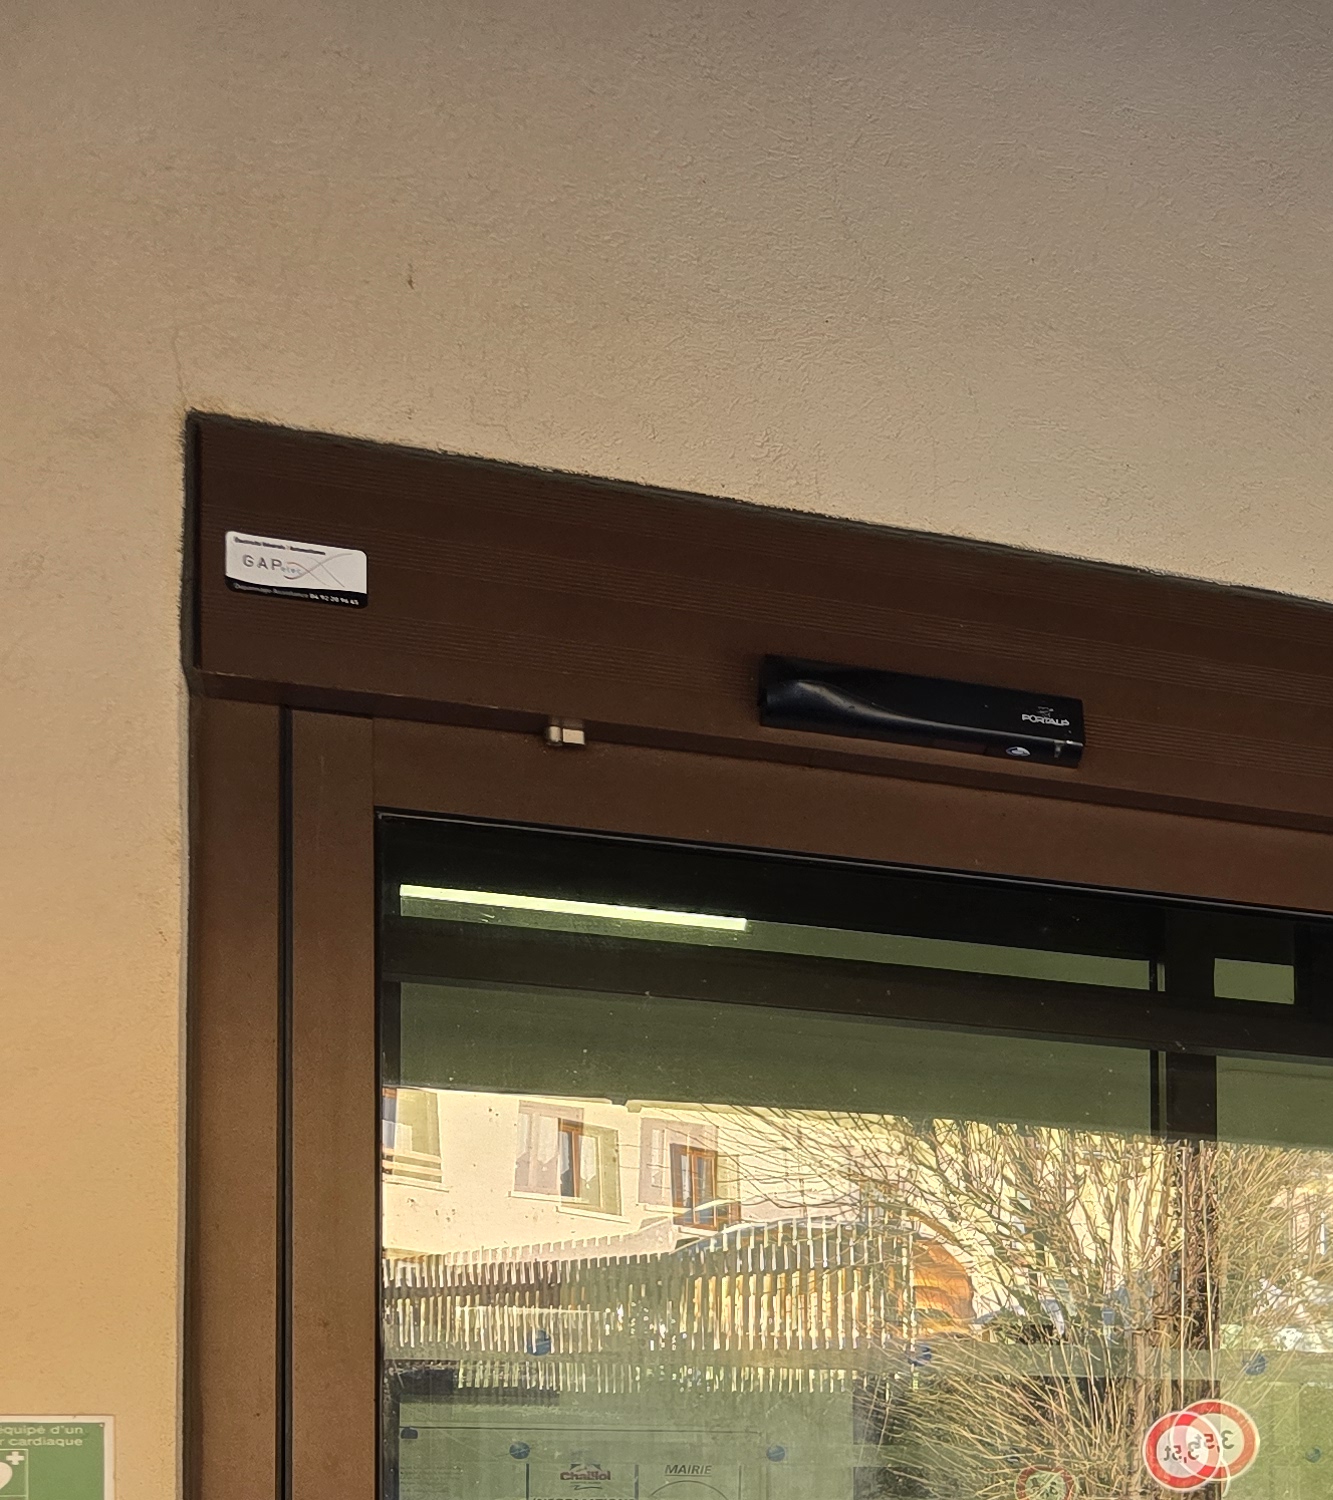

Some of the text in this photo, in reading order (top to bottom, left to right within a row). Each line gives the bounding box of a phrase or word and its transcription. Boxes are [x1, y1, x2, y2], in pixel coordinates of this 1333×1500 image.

[242, 554, 283, 571] GAP
[1022, 714, 1070, 726] PORTALP
[50, 1425, 83, 1435] d'un
[8, 1437, 83, 1447] cardiaque
[664, 1464, 712, 1475] MAIRIE
